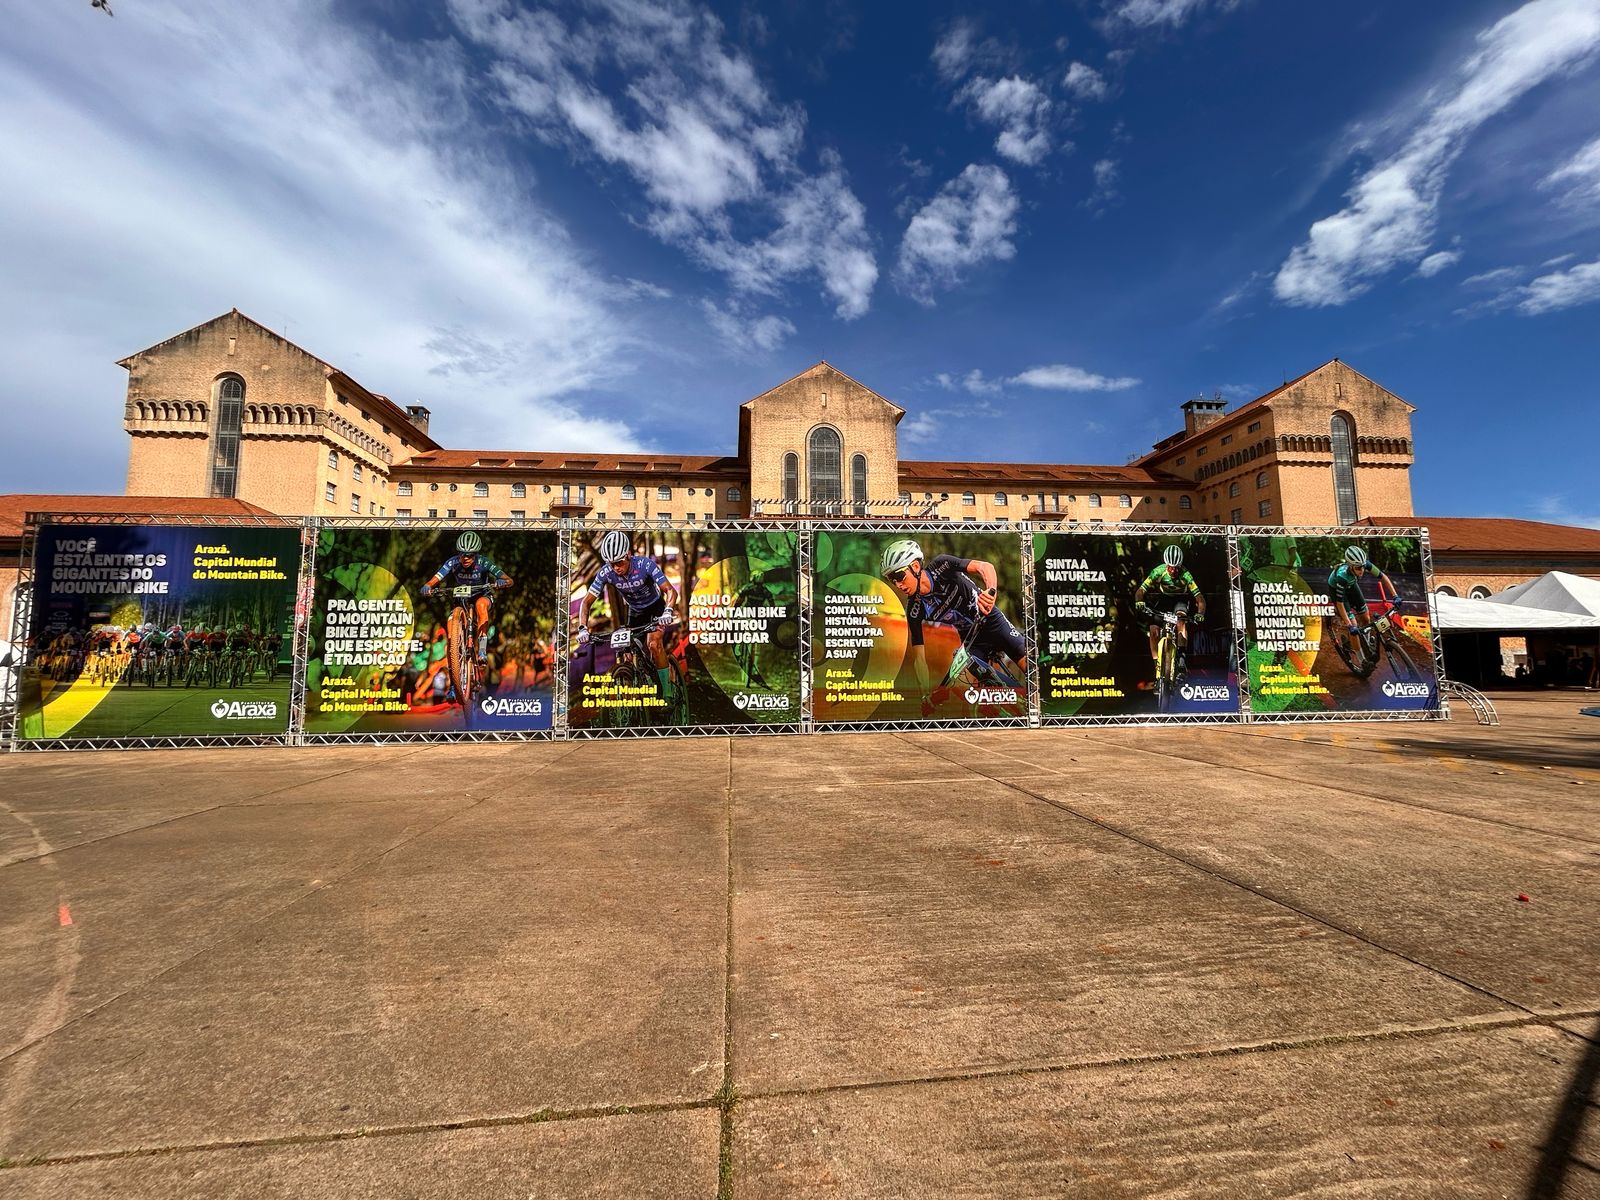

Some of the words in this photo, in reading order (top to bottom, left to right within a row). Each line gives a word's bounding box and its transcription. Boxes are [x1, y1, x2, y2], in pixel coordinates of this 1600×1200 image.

[56, 537, 97, 552] VOCÊ
[194, 544, 230, 554] Araxá.
[53, 552, 94, 566] ESTÁ
[94, 554, 143, 566] ENTRE
[145, 554, 167, 567] OS
[193, 557, 232, 568] Capital
[234, 557, 276, 567] Mundial
[1045, 558, 1080, 570] SINTA
[1080, 558, 1089, 570] A
[52, 567, 129, 580] GIGANTES
[131, 568, 153, 580] DO
[192, 570, 206, 579] do
[207, 570, 258, 579] Mountain
[260, 570, 287, 579] Bike.
[1045, 570, 1106, 582] NATUREZA
[51, 581, 132, 594] MOUNTAIN
[133, 581, 169, 594] BIKE
[615, 579, 645, 589] CALOI
[1252, 580, 1293, 593] ARAXÁ:
[688, 594, 720, 606] AQUI
[722, 594, 731, 605] O
[824, 595, 851, 604] CADA
[851, 595, 884, 604] TRILHA
[1046, 594, 1106, 606] ENFRENTE
[1253, 594, 1262, 605] O
[1262, 592, 1313, 607] CORAÇÃO
[1313, 594, 1329, 605] DO
[327, 599, 357, 611] PRA
[358, 599, 407, 612] GENTE,
[824, 606, 857, 615] CONTA
[857, 606, 878, 615] UMA
[689, 607, 756, 618] MOUNTAIN
[757, 607, 786, 618] BIKE
[1047, 606, 1056, 618] O
[1057, 606, 1106, 618] DESAFIO
[1254, 606, 1310, 617] MOUNTAIN
[1311, 606, 1336, 616] BIKE
[326, 613, 337, 624] O
[338, 613, 413, 624] MOUNTAIN
[825, 615, 871, 626] HISTÓRIA.
[1255, 617, 1304, 628] MUNDIAL
[689, 619, 767, 631] ENCONTROU
[1380, 621, 1386, 629] 5
[325, 626, 358, 638] BIKE
[360, 624, 369, 638] É
[370, 626, 406, 638] MAIS
[825, 627, 864, 637] PRONTO
[864, 627, 883, 637] PRA
[1048, 630, 1113, 642] SUPERE-SE
[1256, 629, 1306, 640] BATENDO
[613, 632, 628, 642] 33
[689, 632, 698, 644] O
[700, 632, 725, 644] SEU
[726, 632, 769, 644] LUGAR
[324, 640, 354, 652] QUE
[355, 640, 424, 652] ESPORTE:
[825, 638, 874, 648] ESCREVER
[1049, 643, 1067, 654] EM
[1067, 640, 1108, 654] ARAXÁ
[1257, 640, 1285, 652] MAIS
[1285, 640, 1320, 651] FORTE
[323, 651, 332, 666] É
[333, 651, 406, 668] TRADIÇÃO
[825, 649, 833, 659] A
[833, 649, 858, 659] SUA?
[825, 668, 855, 678] Araxá.
[1050, 665, 1078, 675] Araxá.
[1259, 664, 1285, 672] Araxá.
[321, 676, 356, 686] Araxá.
[582, 673, 615, 682] Araxá.
[1050, 677, 1081, 688] Capital
[1082, 677, 1115, 686] Mundial
[1259, 675, 1289, 685] Capital
[1289, 674, 1320, 683] Mundial
[582, 685, 618, 697] Capital
[619, 685, 657, 694] Mundial
[825, 680, 858, 692] Capital
[859, 680, 894, 689] Mundial
[1261, 686, 1271, 695] do
[1272, 686, 1308, 694] Mountain
[1309, 685, 1330, 694] Bike.
[320, 689, 358, 700] Capital
[360, 688, 400, 698] Mundial
[825, 692, 837, 702] do
[838, 692, 880, 702] Mountain
[881, 692, 905, 701] Bike.
[1051, 688, 1062, 698] do
[1063, 688, 1102, 698] Mountain
[1103, 688, 1125, 697] Bike.
[320, 702, 333, 712] do
[334, 702, 383, 711] Mountain
[384, 701, 412, 711] Bike.
[582, 698, 595, 708] do
[596, 698, 642, 707] Mountain
[643, 697, 668, 707] Bike.
